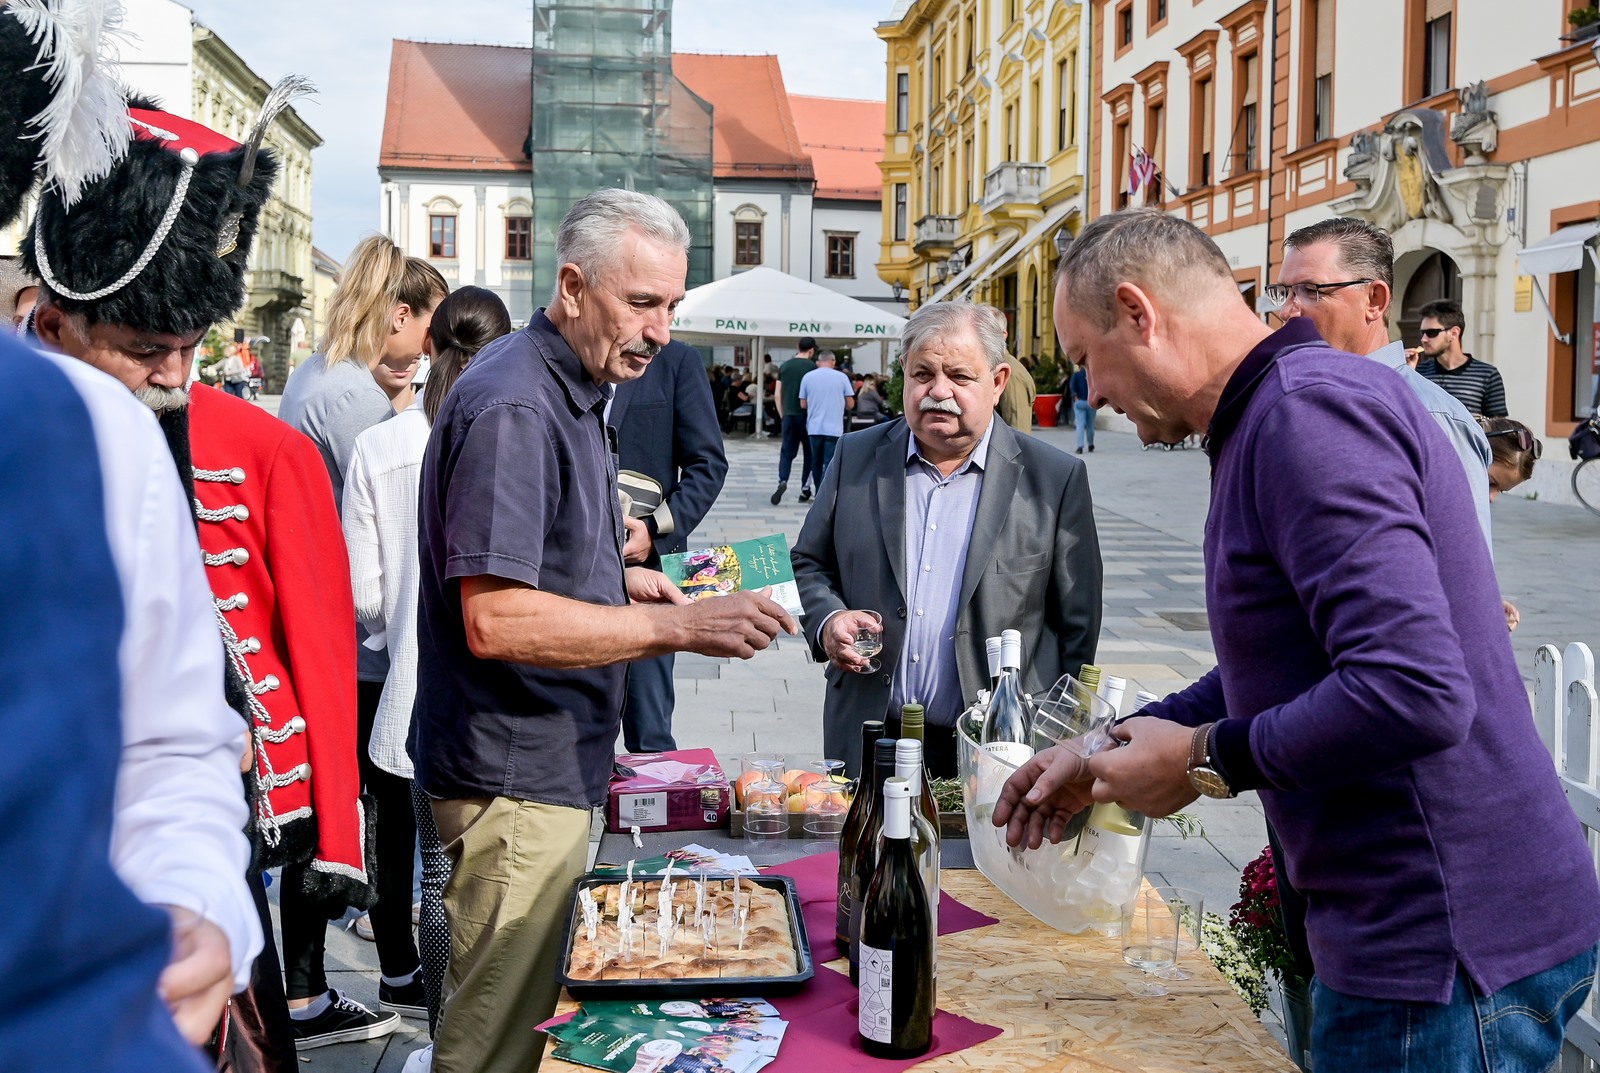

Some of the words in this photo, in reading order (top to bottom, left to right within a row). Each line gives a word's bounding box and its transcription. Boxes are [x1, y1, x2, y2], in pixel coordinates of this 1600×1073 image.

[715, 319, 747, 331] PAN
[789, 322, 820, 333] PAN
[855, 324, 886, 334] PAN
[706, 813, 717, 821] 40
